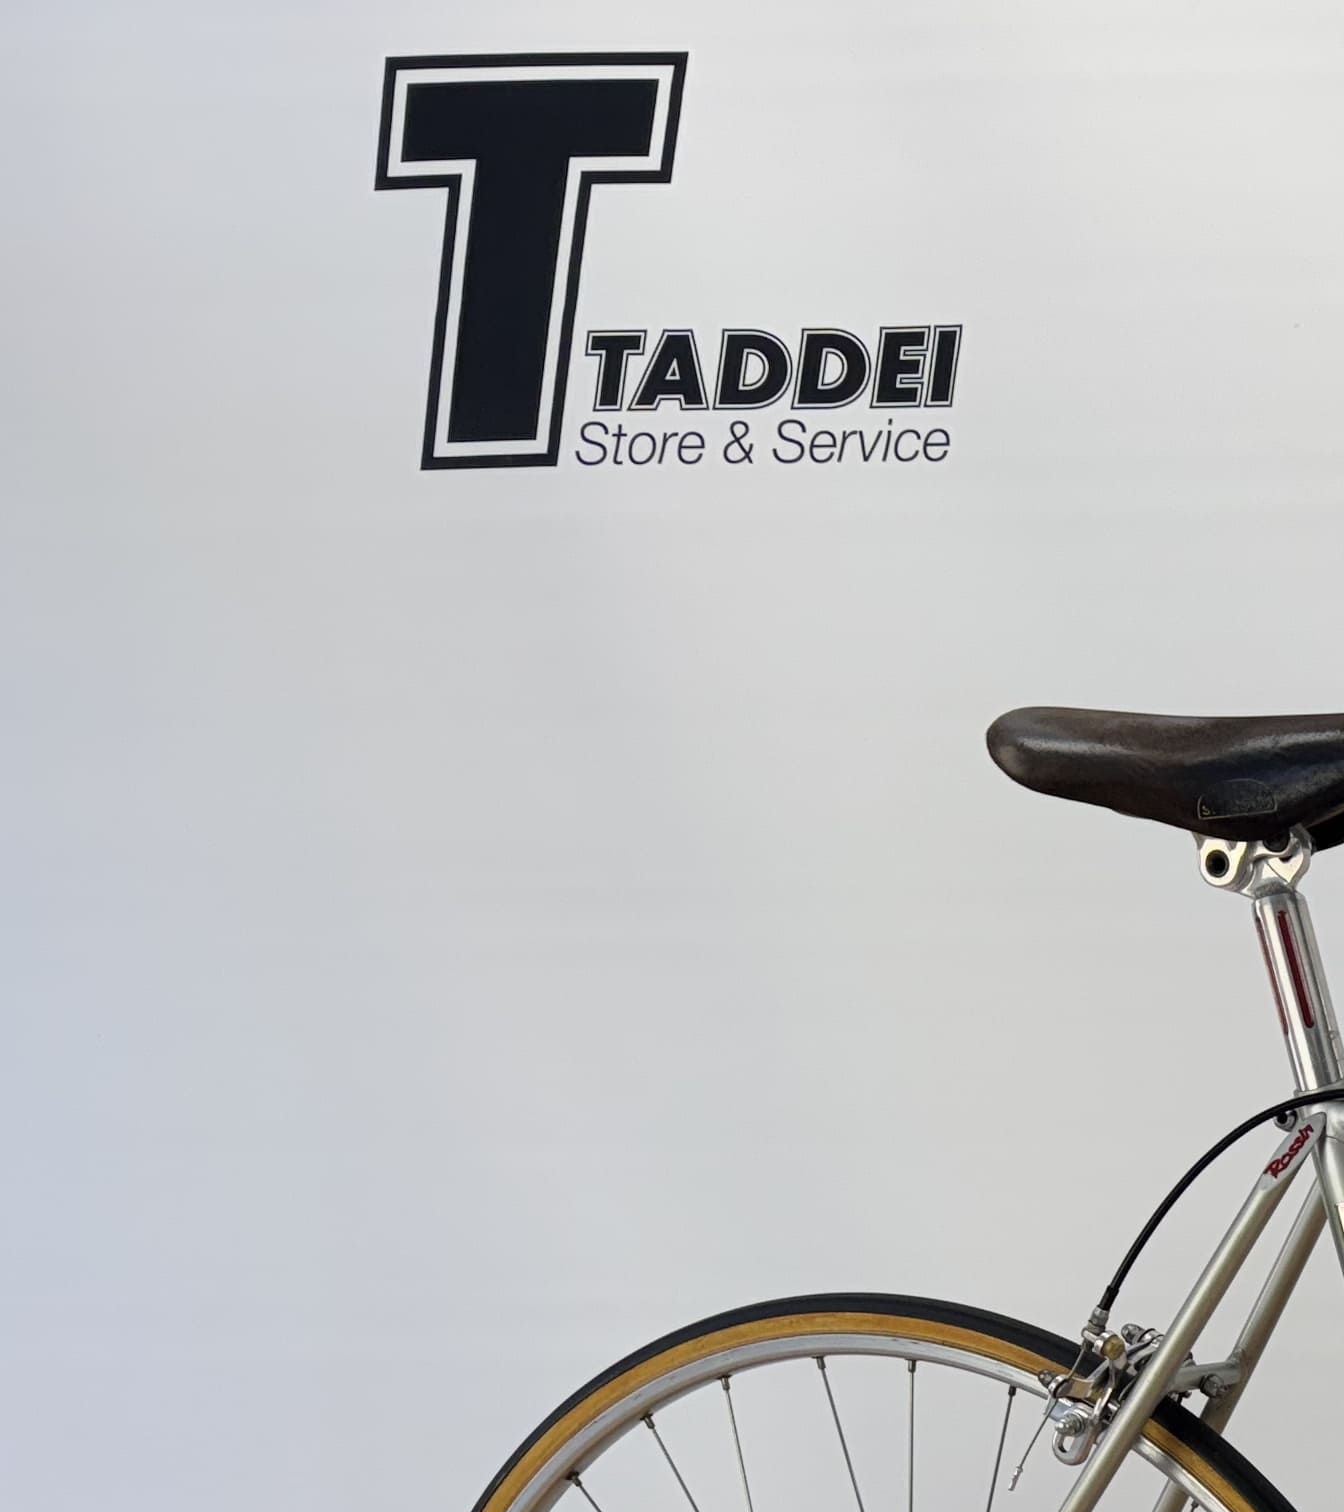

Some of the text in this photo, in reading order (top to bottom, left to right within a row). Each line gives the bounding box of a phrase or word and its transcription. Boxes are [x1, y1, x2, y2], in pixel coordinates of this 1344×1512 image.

[375, 52, 689, 470] T
[585, 325, 963, 412] TADDEI
[575, 418, 951, 466] Store & Service
[1263, 1124, 1314, 1178] Rossin
